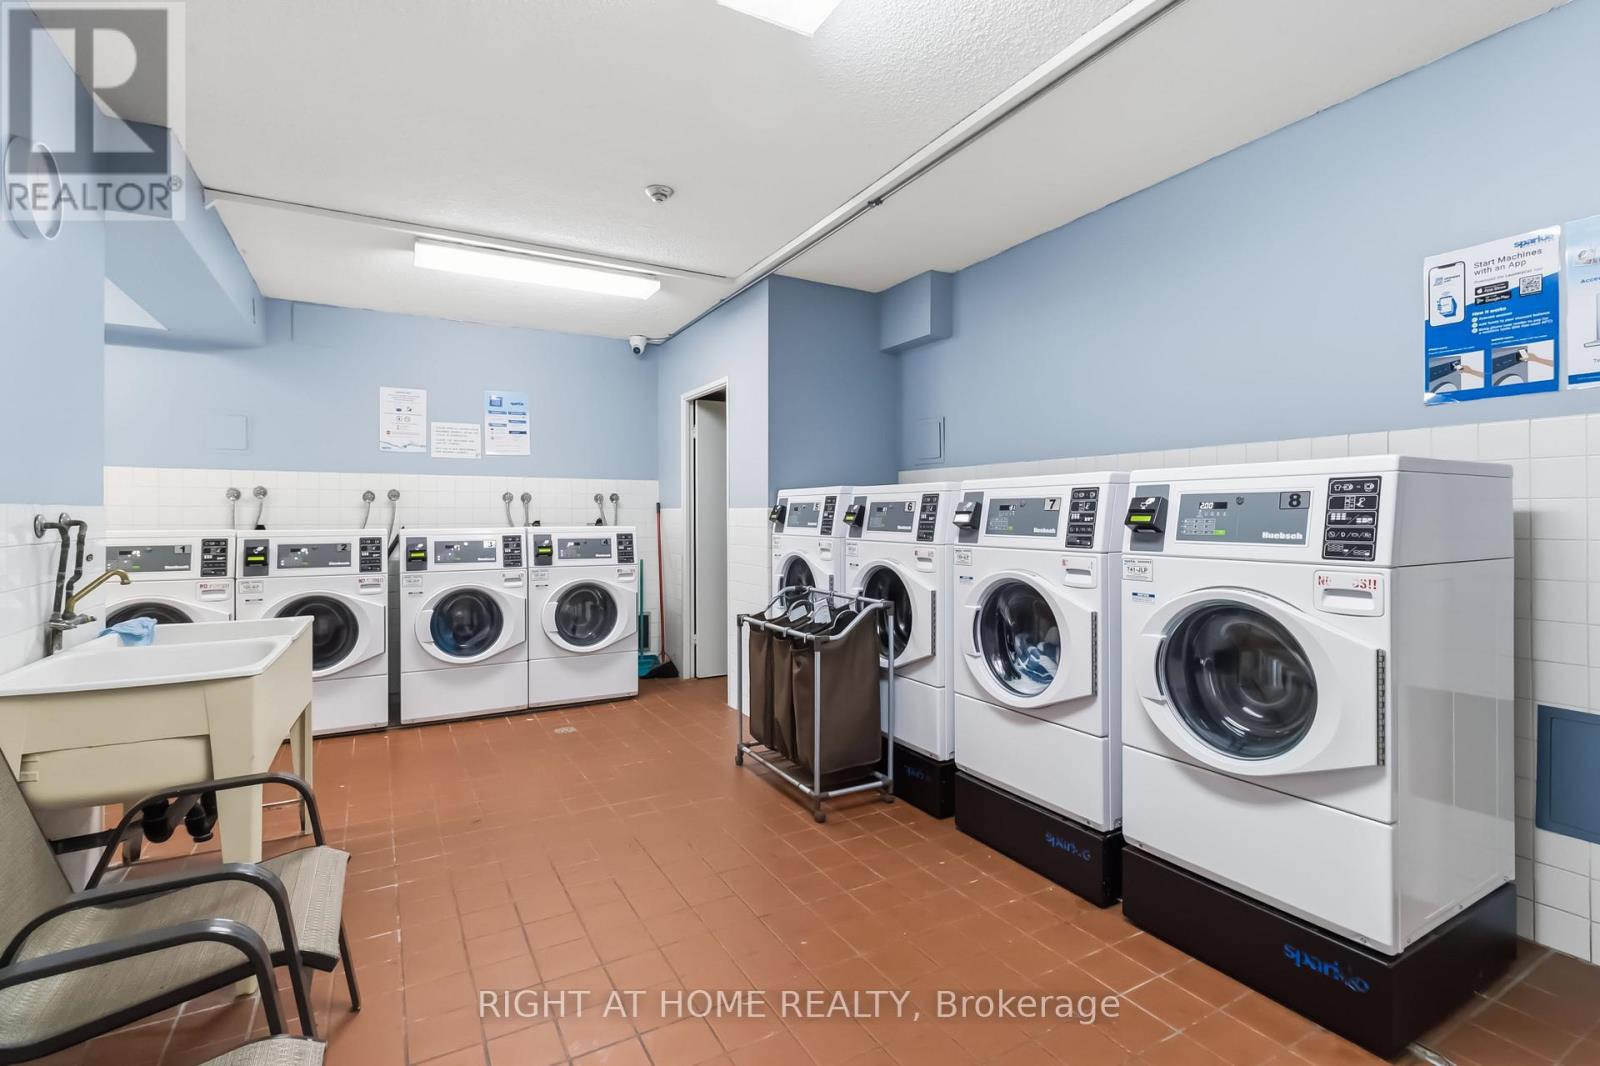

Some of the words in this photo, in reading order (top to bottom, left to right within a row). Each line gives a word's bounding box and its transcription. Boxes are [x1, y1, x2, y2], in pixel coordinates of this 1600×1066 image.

[1473, 258, 1495, 269] Start
[1497, 248, 1543, 264] Machines
[1473, 265, 1492, 276] with
[1494, 264, 1506, 272] an
[1508, 259, 1527, 270] App
[907, 503, 913, 511] 6
[1049, 499, 1057, 510] 7
[1288, 493, 1302, 508] 8
[180, 545, 186, 553] 1
